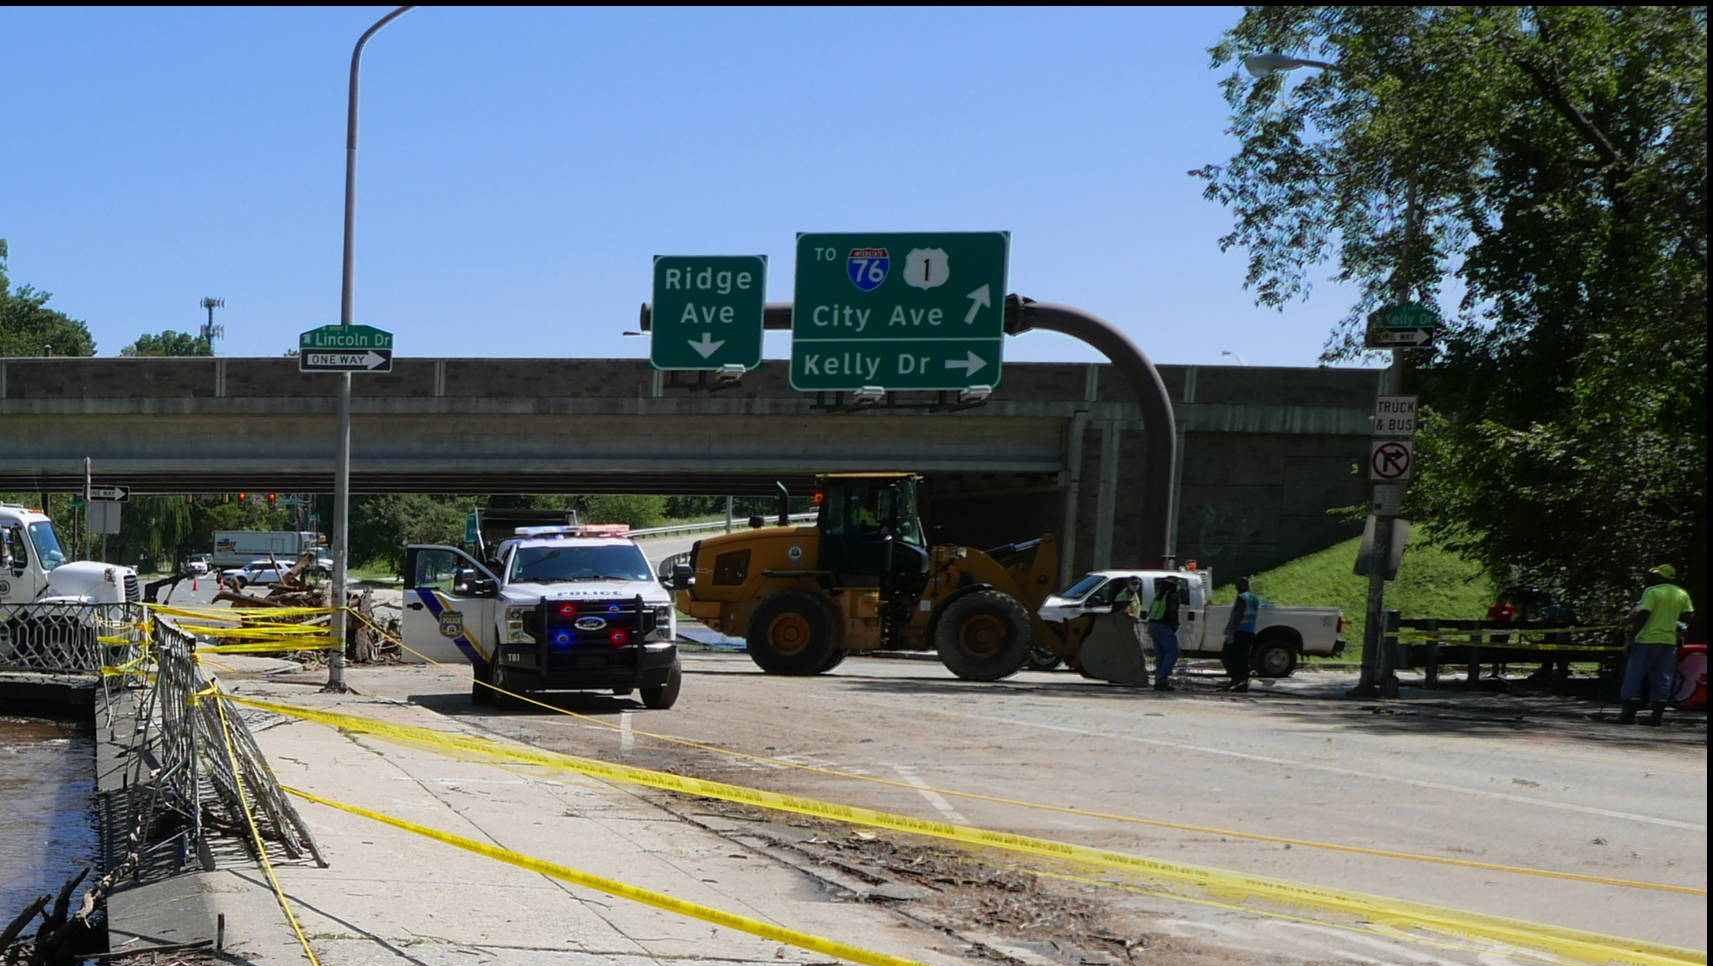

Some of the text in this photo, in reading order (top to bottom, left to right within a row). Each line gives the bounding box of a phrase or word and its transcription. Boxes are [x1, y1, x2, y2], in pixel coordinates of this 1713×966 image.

[815, 247, 930, 282] TO 76 1
[665, 268, 752, 294] Ridge
[681, 303, 735, 323] Ave
[813, 304, 943, 332] City Ave
[1419, 313, 1433, 324] Dr
[315, 332, 368, 346] Lincoln
[374, 333, 390, 346] Dr
[312, 355, 366, 365] ONE WAY
[804, 354, 931, 380] Kelly Dr
[1377, 401, 1415, 414] TRUCK
[1375, 419, 1413, 431] & BUS
